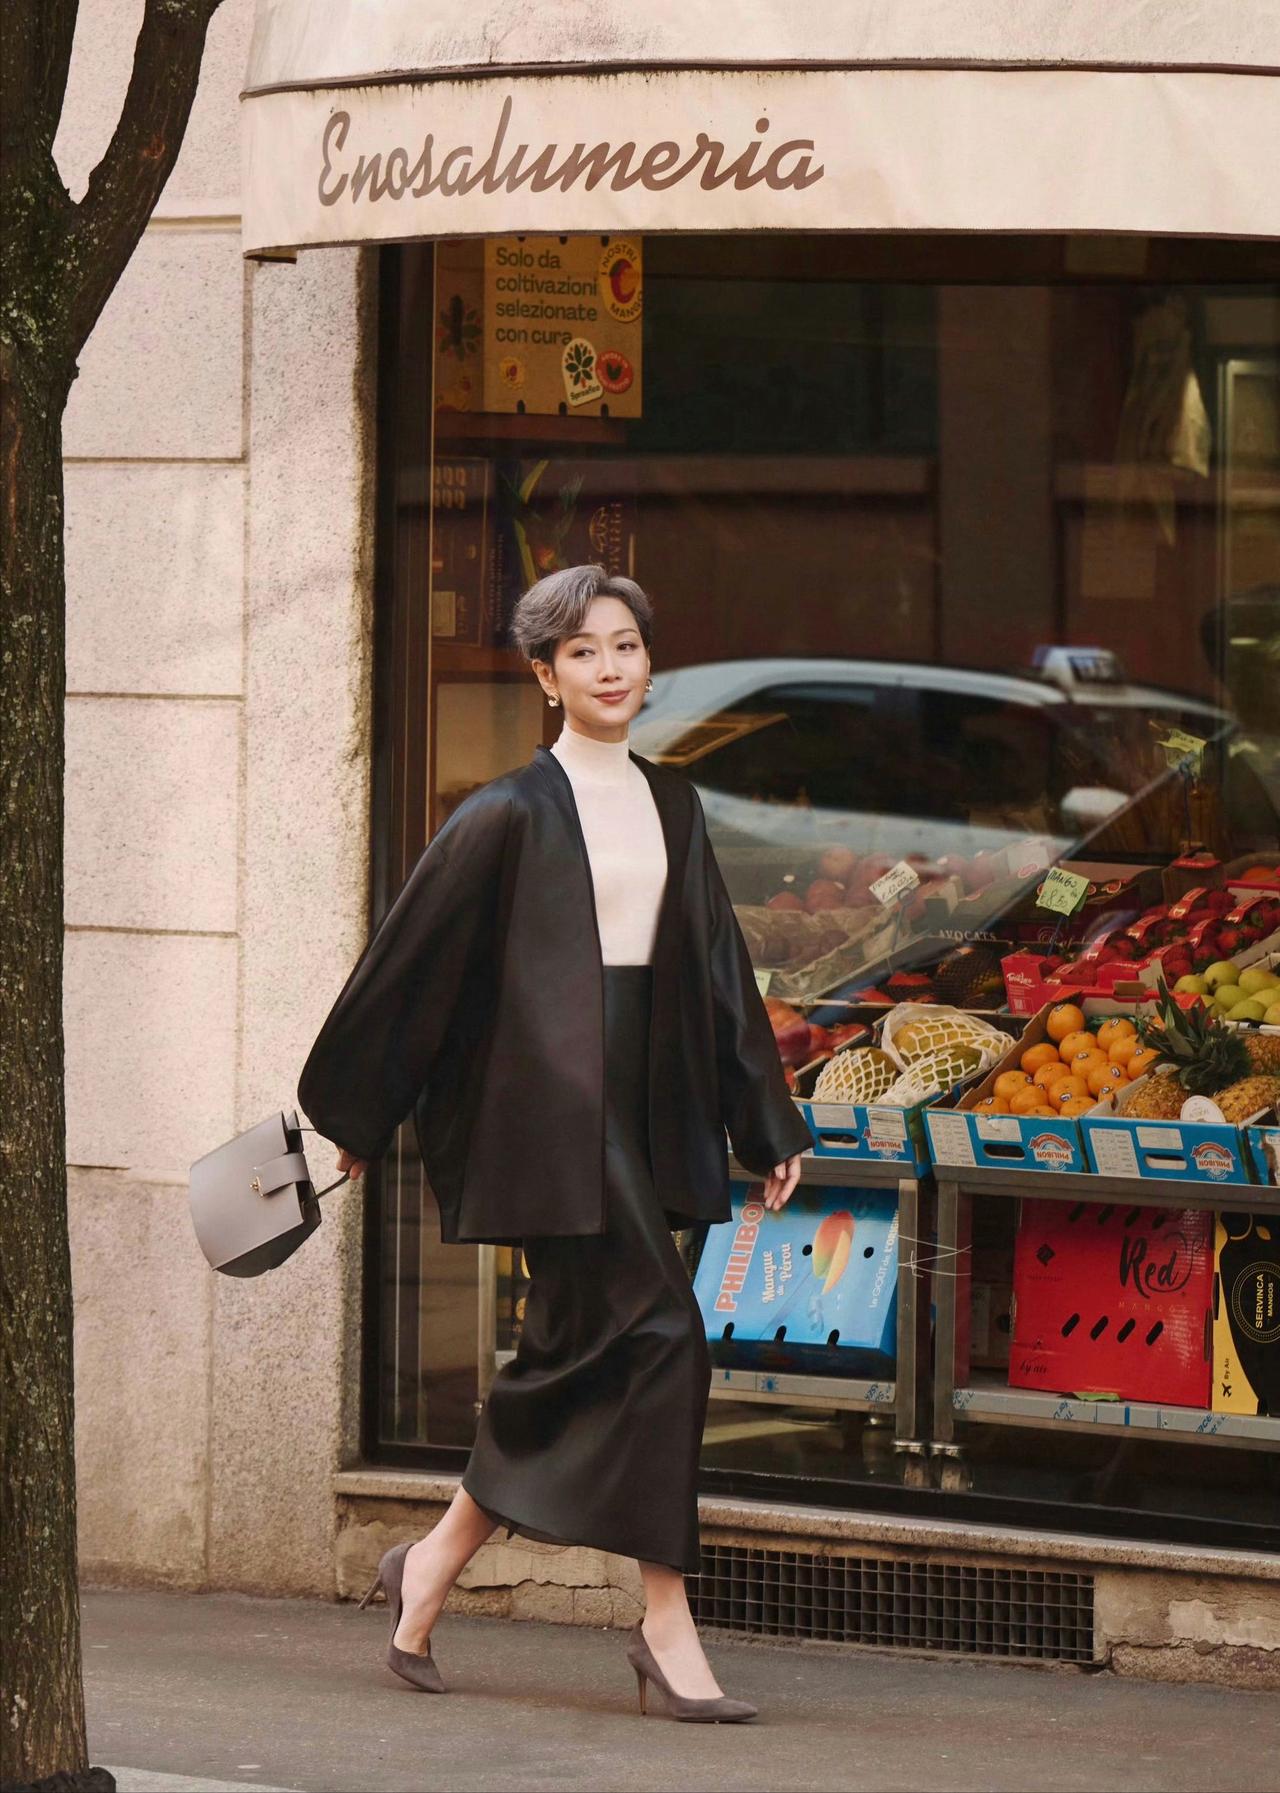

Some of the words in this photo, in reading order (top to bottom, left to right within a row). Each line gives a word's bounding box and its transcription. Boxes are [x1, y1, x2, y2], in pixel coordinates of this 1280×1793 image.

[318, 96, 824, 206] Enosalumeria
[496, 247, 534, 267] Solo
[538, 251, 561, 269] da
[601, 243, 637, 268] NOSTRI
[496, 273, 598, 297] coltivazioni
[496, 298, 598, 322] selezionate
[496, 328, 528, 344] con
[531, 330, 573, 346] cura
[939, 929, 997, 942] AVOCATS
[871, 1141, 902, 1150] PHILIBON
[1036, 1151, 1069, 1161] PHILIBON
[1199, 1159, 1231, 1169] PHILIBON
[779, 1242, 794, 1282] Pérou
[1120, 1232, 1192, 1298] Red
[762, 1249, 778, 1303] Mangue
[1255, 1273, 1264, 1329] SERVINCA
